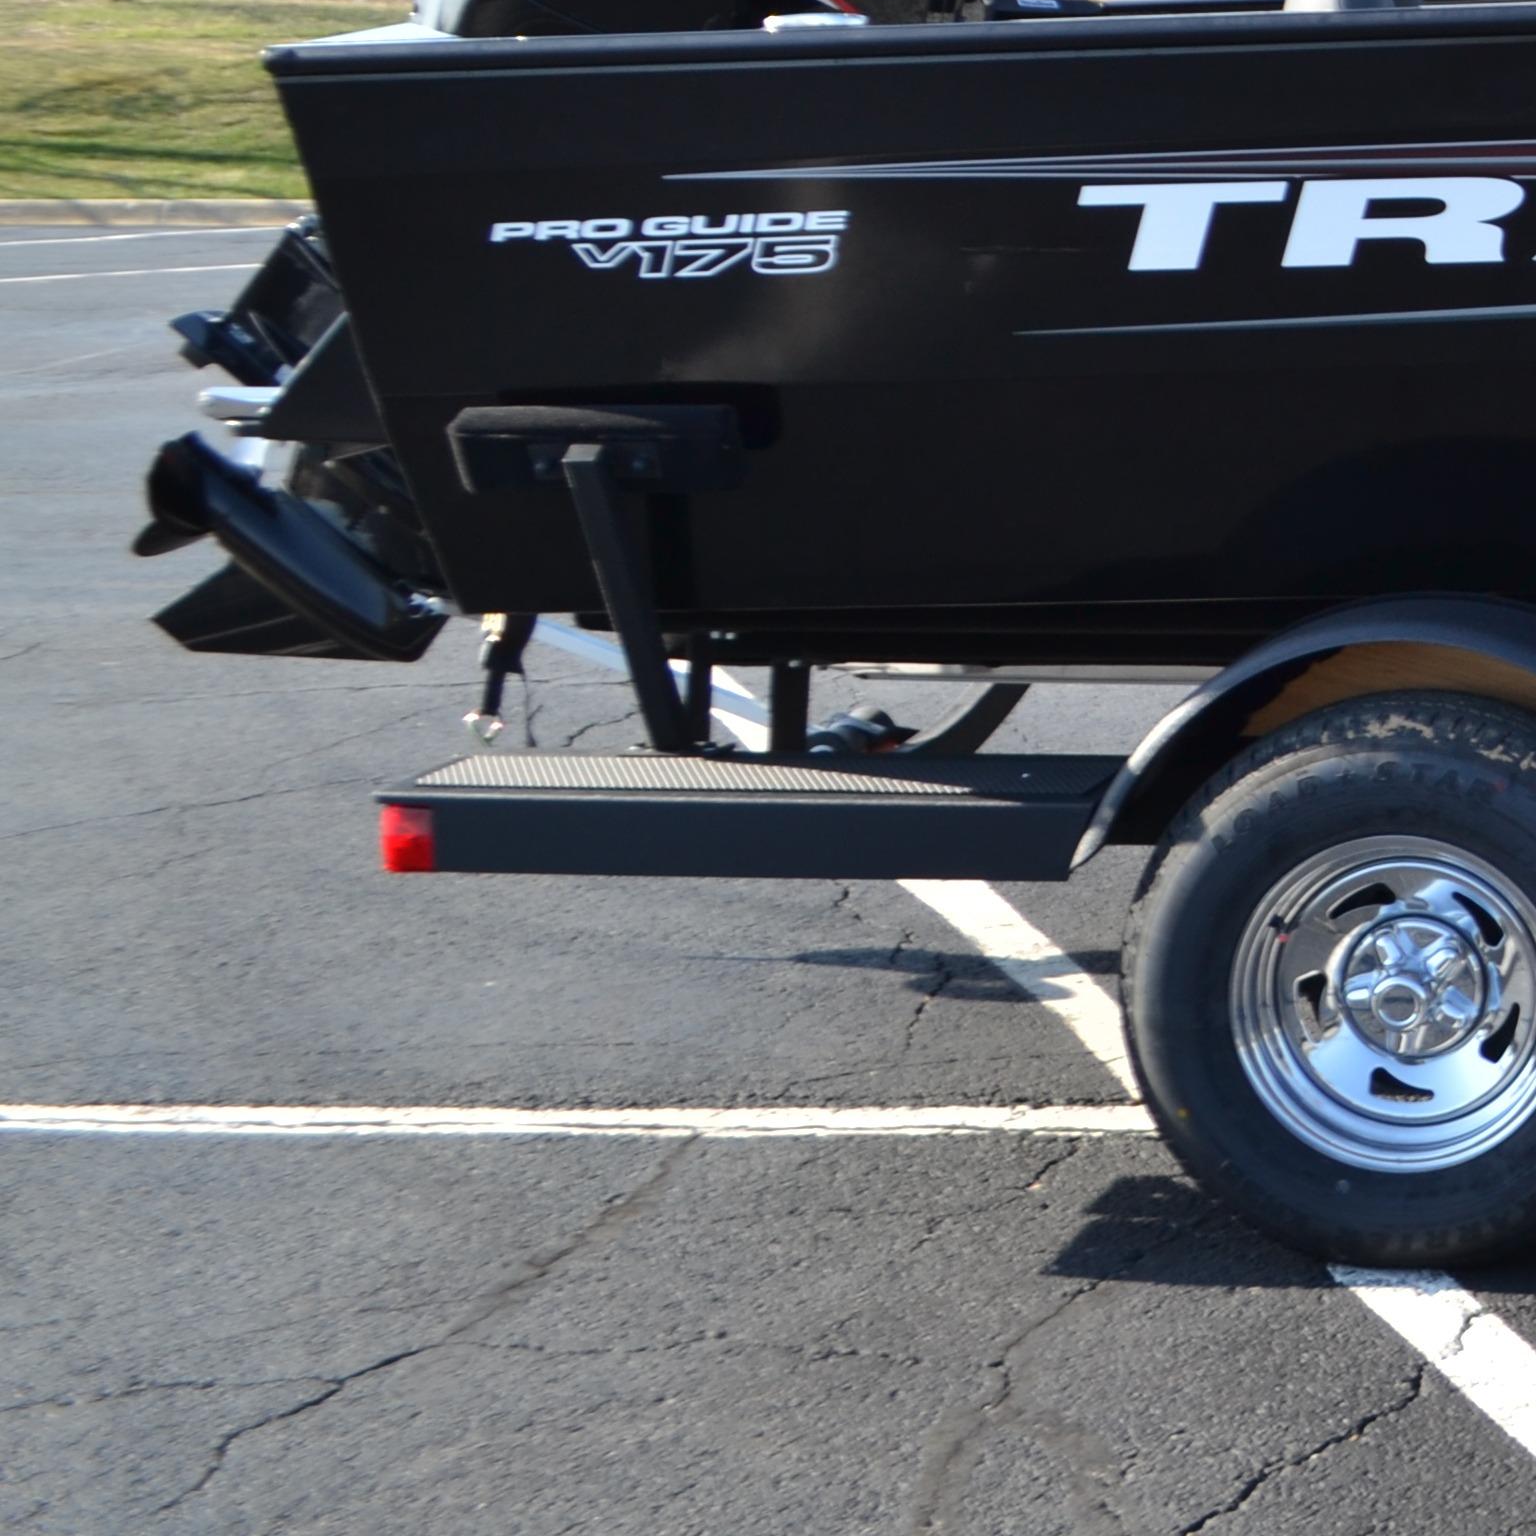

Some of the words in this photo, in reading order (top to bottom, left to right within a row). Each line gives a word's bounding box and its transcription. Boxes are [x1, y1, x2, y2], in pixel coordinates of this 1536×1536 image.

[489, 216, 633, 243] PRO
[639, 208, 852, 238] GUIDE
[570, 233, 841, 279] V175
